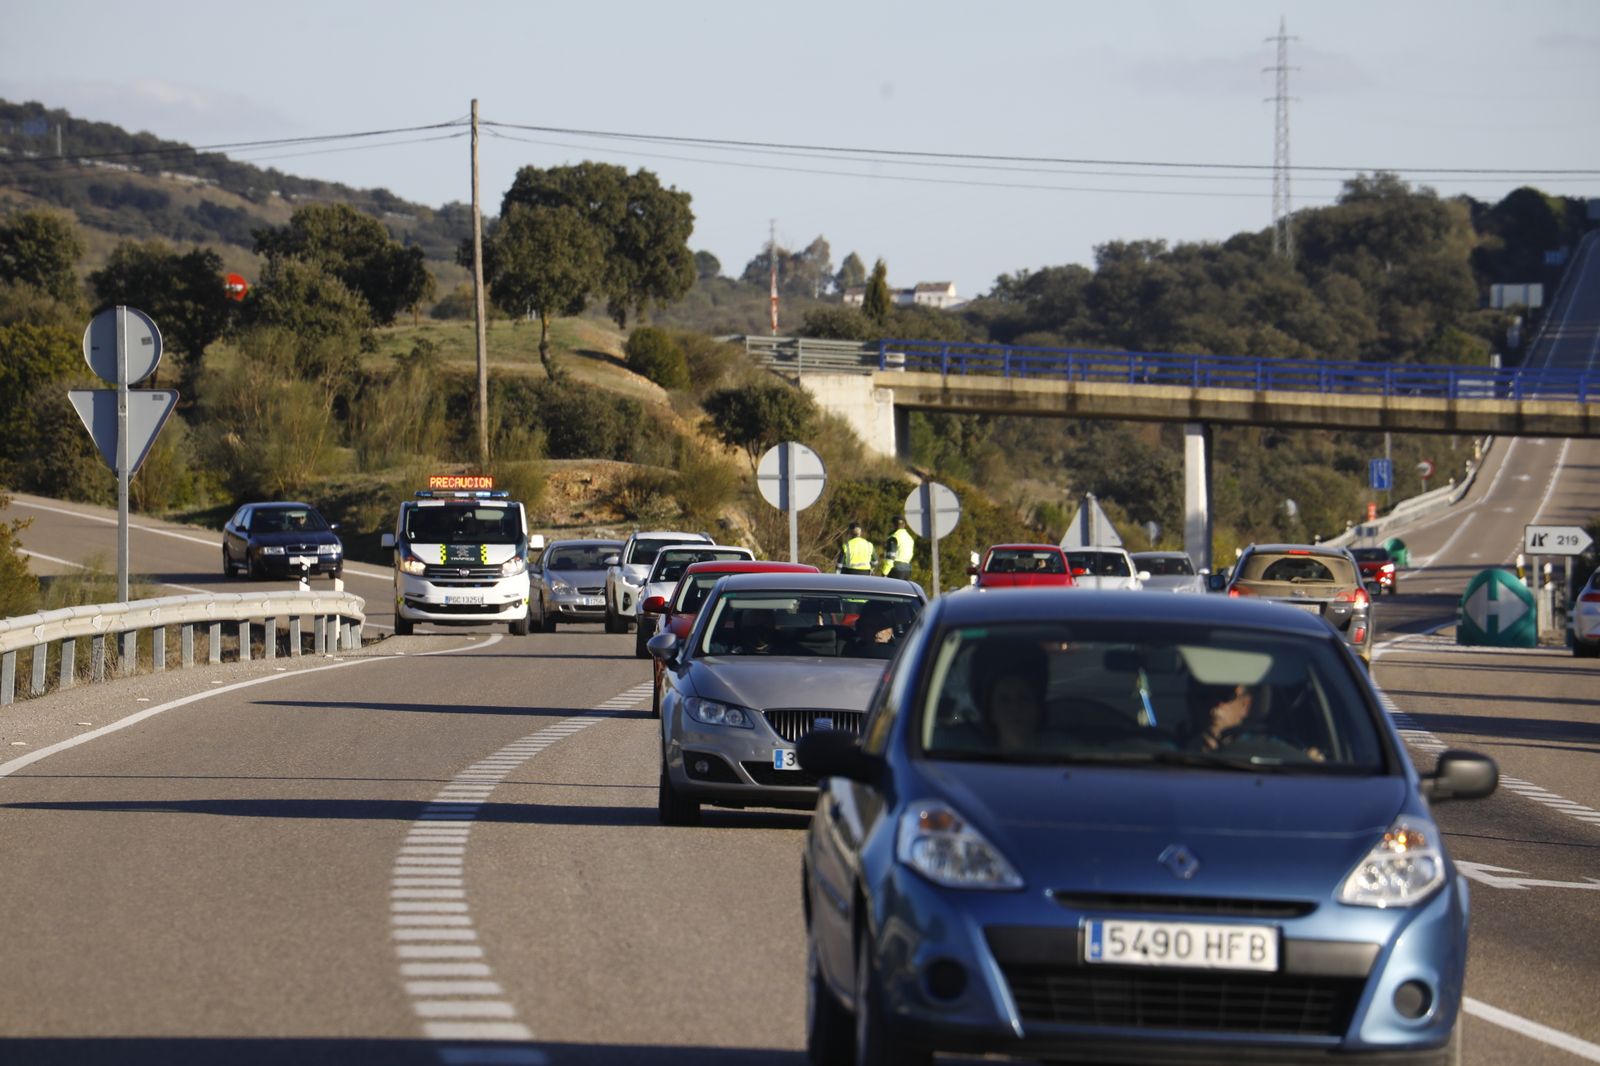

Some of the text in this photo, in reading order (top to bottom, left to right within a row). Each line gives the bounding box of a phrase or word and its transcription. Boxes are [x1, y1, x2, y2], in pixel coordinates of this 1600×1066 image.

[429, 476, 493, 489] PRECAUCION
[1556, 535, 1579, 546] 219
[1107, 925, 1267, 963] 5490 HFB
